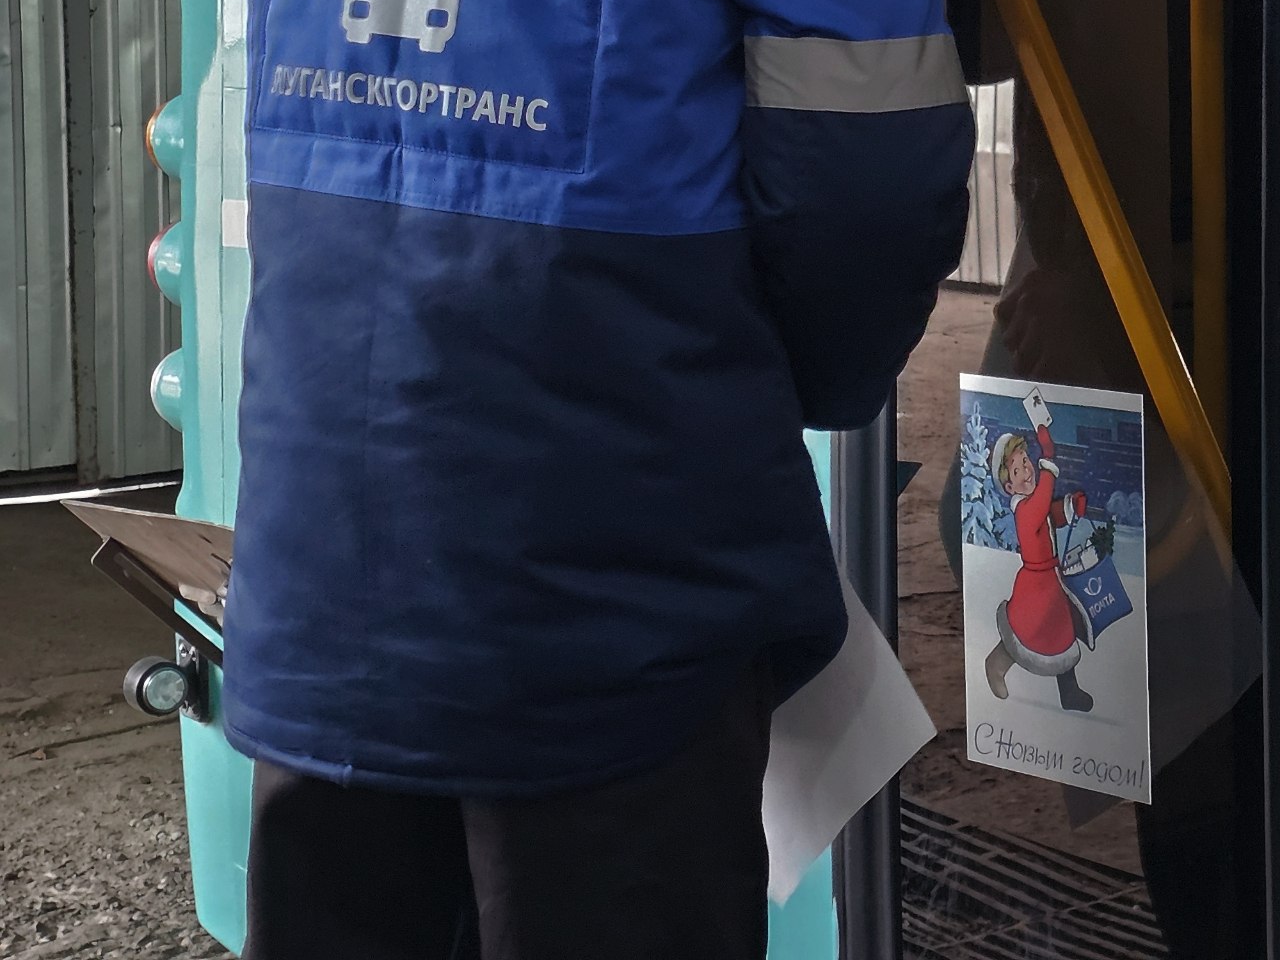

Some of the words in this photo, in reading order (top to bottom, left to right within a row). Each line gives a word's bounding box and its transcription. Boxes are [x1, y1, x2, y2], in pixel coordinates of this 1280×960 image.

[271, 64, 549, 132] ЛУГАНСКГОРТРАНС
[1088, 592, 1116, 619] ПОЧТА
[974, 722, 994, 755] С
[995, 728, 1064, 771] Новым
[1072, 756, 1146, 789] годом!
